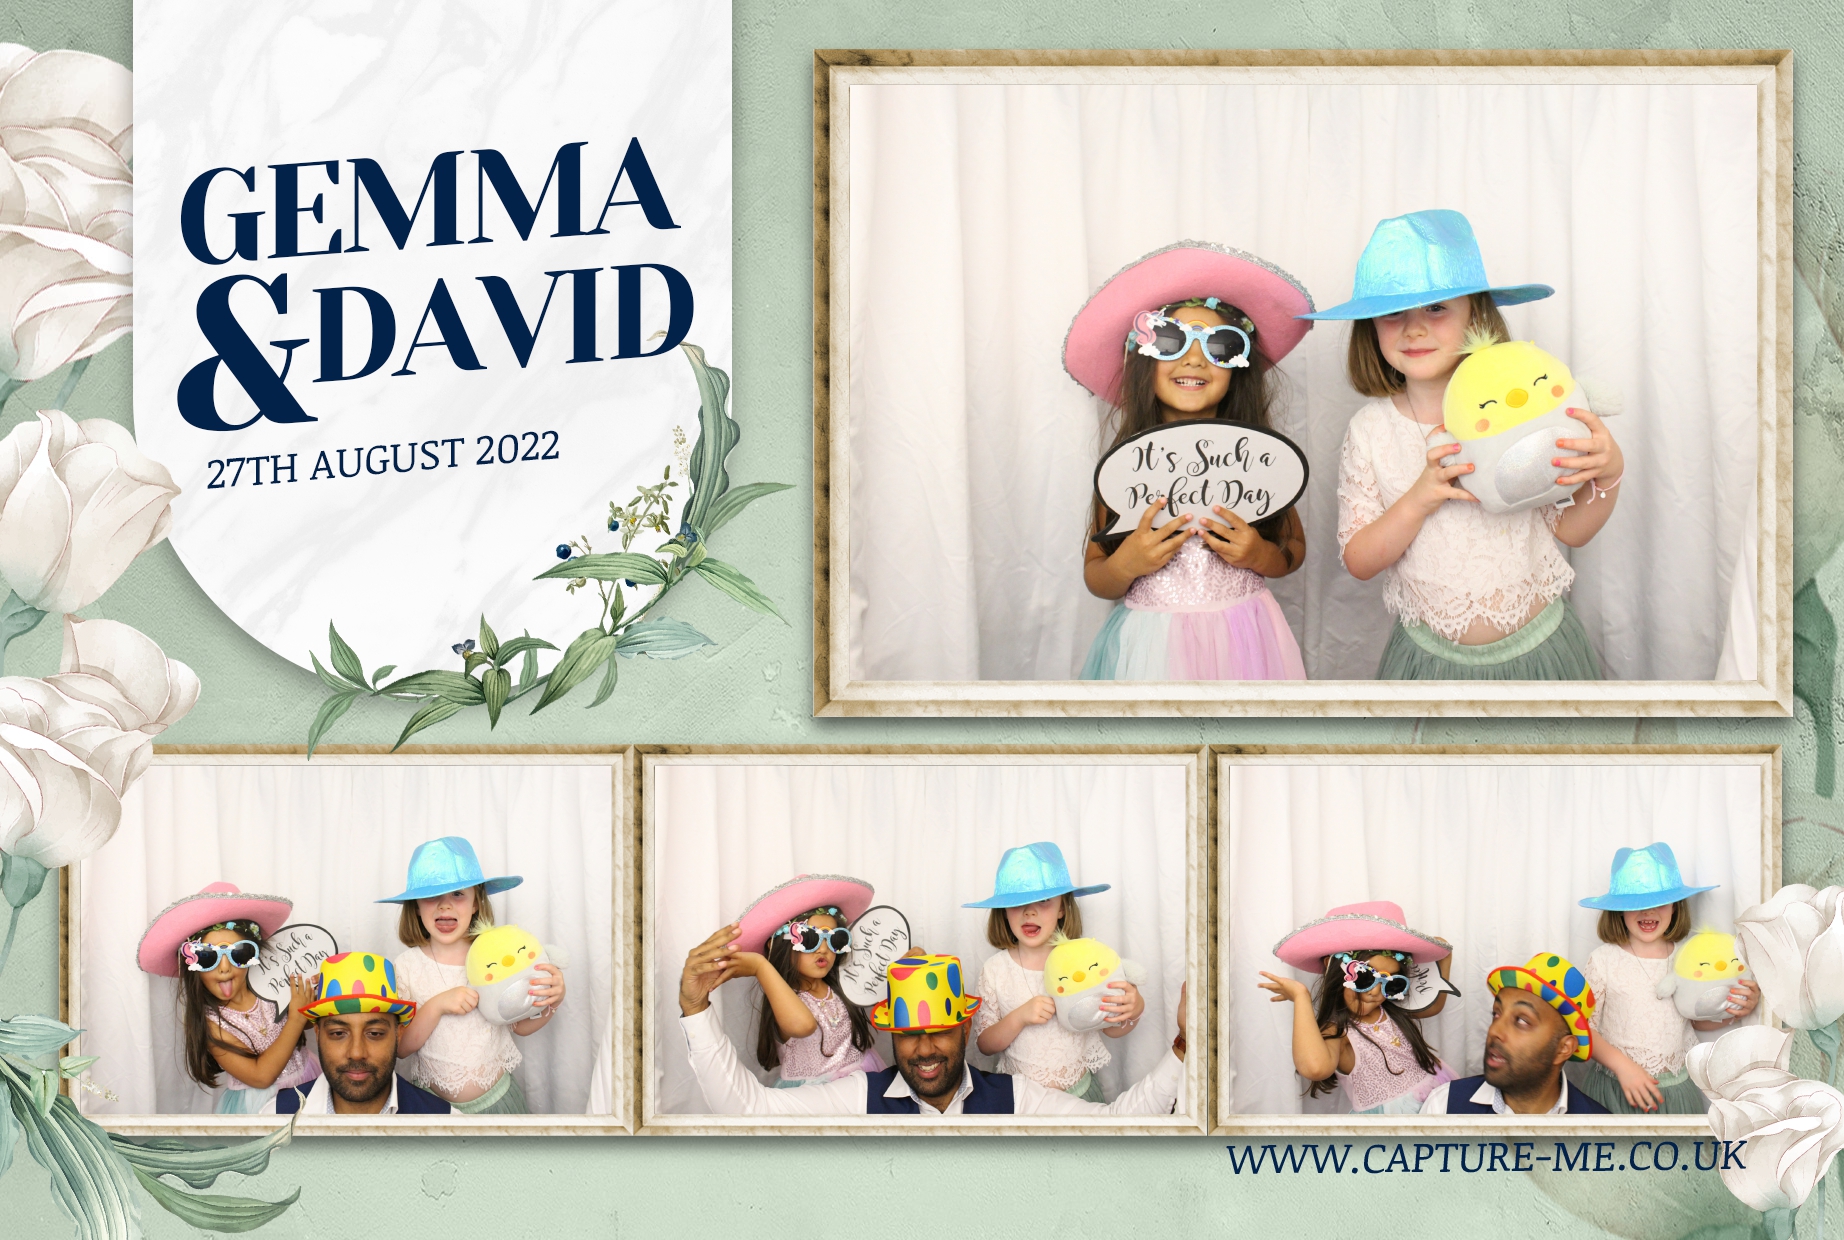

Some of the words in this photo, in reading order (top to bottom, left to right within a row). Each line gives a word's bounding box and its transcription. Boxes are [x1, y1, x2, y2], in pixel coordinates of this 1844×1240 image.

[1132, 441, 1181, 473] It's
[1186, 437, 1254, 477] Such
[1260, 452, 1276, 467] a
[1217, 480, 1276, 516] Day
[872, 918, 881, 926] a
[276, 932, 307, 963] Such
[305, 933, 313, 941] a
[853, 926, 879, 962] Such
[880, 927, 907, 952] Day
[843, 962, 865, 983] It's
